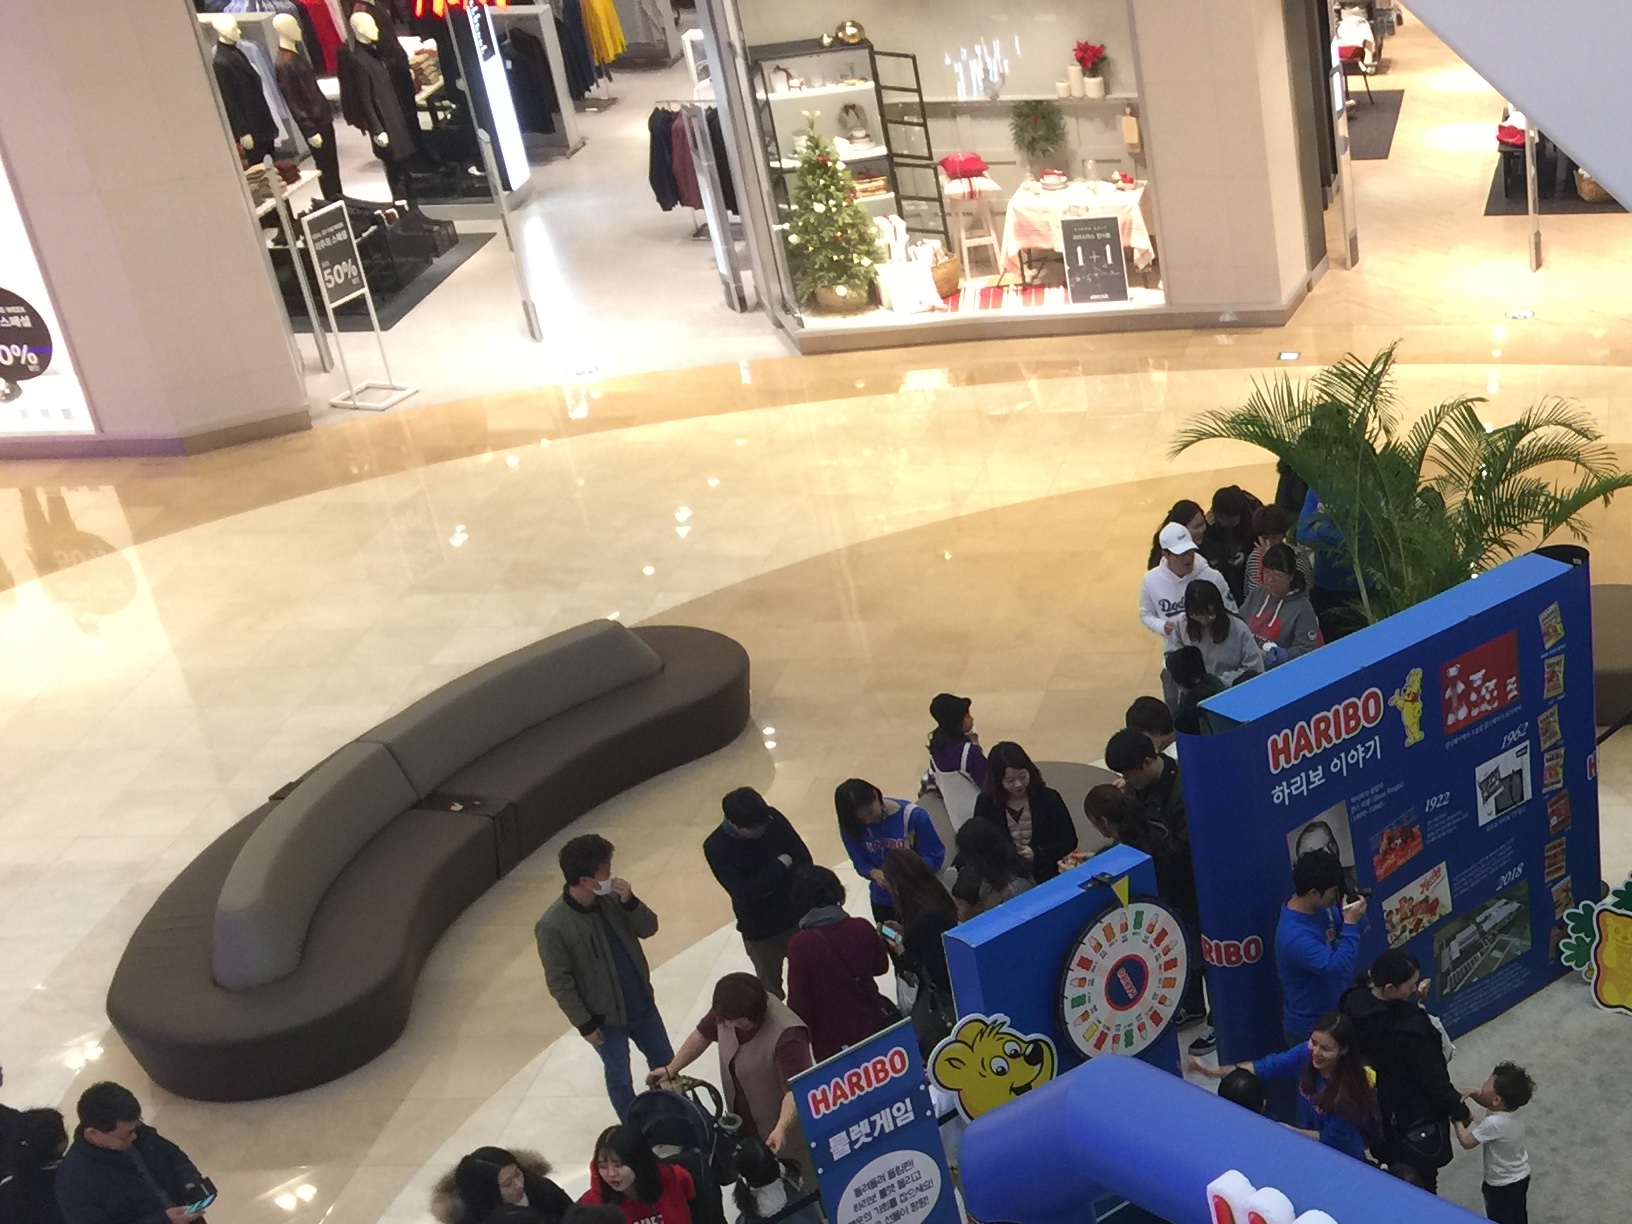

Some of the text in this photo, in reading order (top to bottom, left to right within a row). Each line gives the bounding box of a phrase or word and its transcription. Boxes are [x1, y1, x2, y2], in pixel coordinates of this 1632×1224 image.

[323, 258, 358, 289] 50%
[1267, 687, 1384, 775] HARIBO
[1500, 721, 1529, 751] 1962
[1271, 771, 1326, 806] 하리보
[1329, 735, 1382, 777] 이야기
[1424, 790, 1451, 812] 1922
[1495, 861, 1525, 892] 2018
[807, 1046, 909, 1119] HARIBO
[828, 1096, 916, 1162] 룰렛게임
